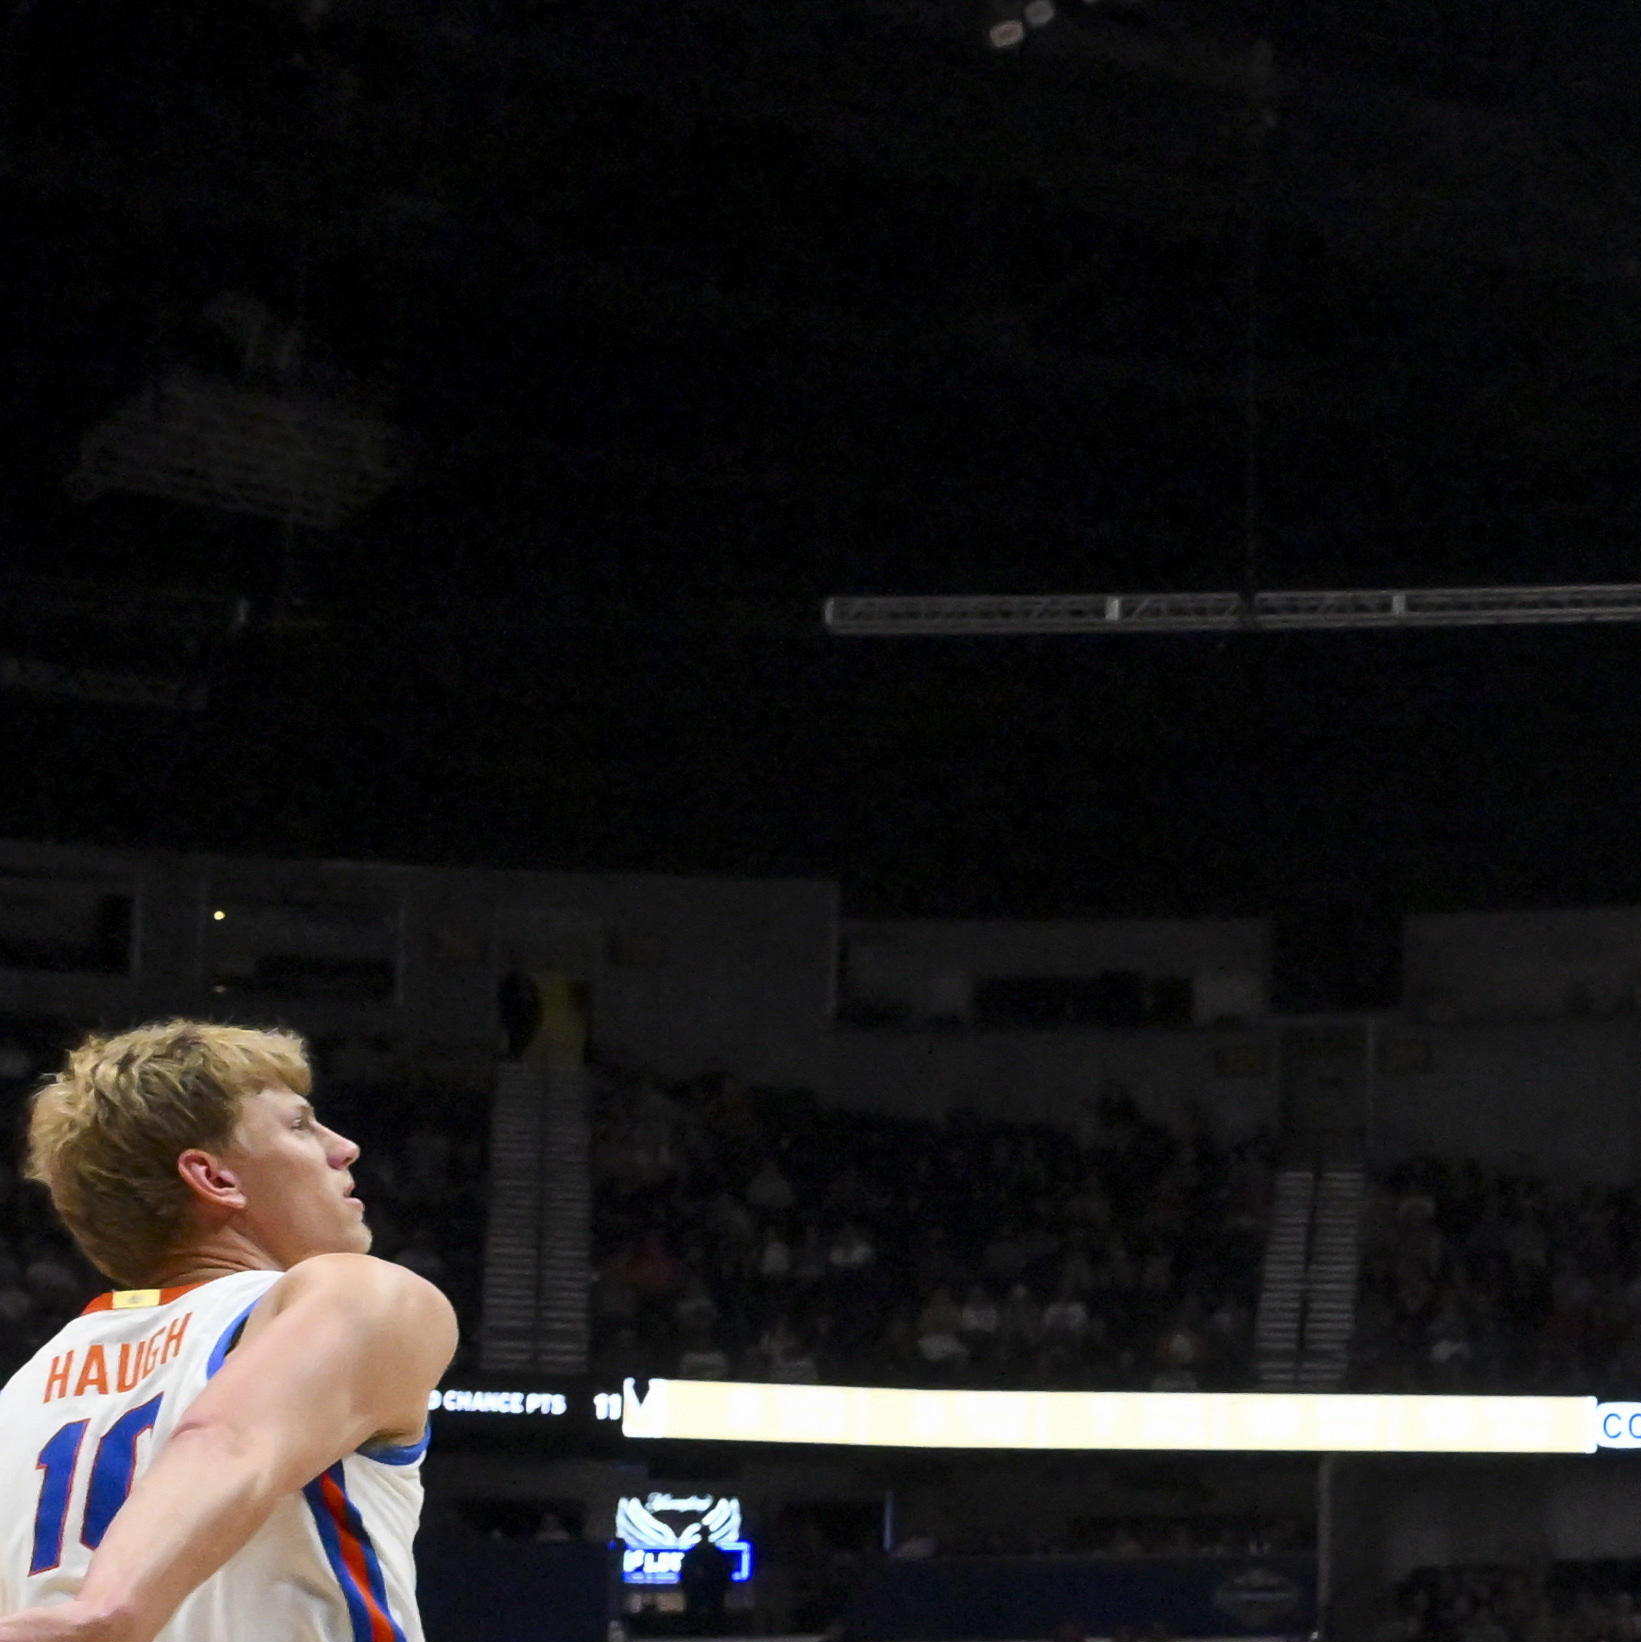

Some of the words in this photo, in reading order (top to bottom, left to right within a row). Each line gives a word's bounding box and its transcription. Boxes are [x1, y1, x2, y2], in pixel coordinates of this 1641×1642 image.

[43, 1313, 192, 1404] HAUGH
[443, 1389, 525, 1414] CHANCE
[526, 1393, 567, 1416] PTS
